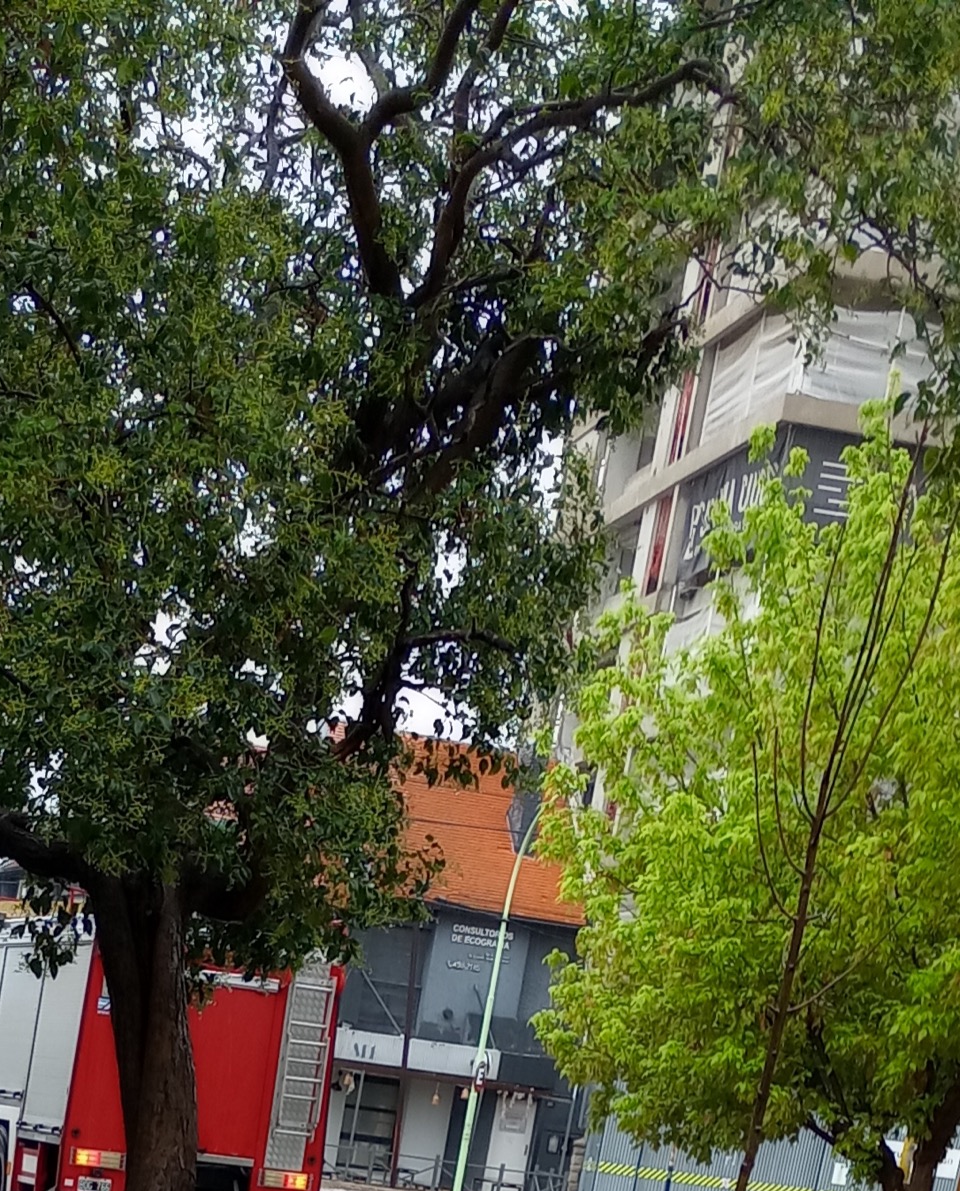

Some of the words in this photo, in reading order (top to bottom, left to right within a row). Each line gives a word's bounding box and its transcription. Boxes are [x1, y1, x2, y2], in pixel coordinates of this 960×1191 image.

[453, 924, 514, 940] CONSULTOROS
[451, 934, 463, 943] DE
[464, 935, 510, 950] ECOGRAA
